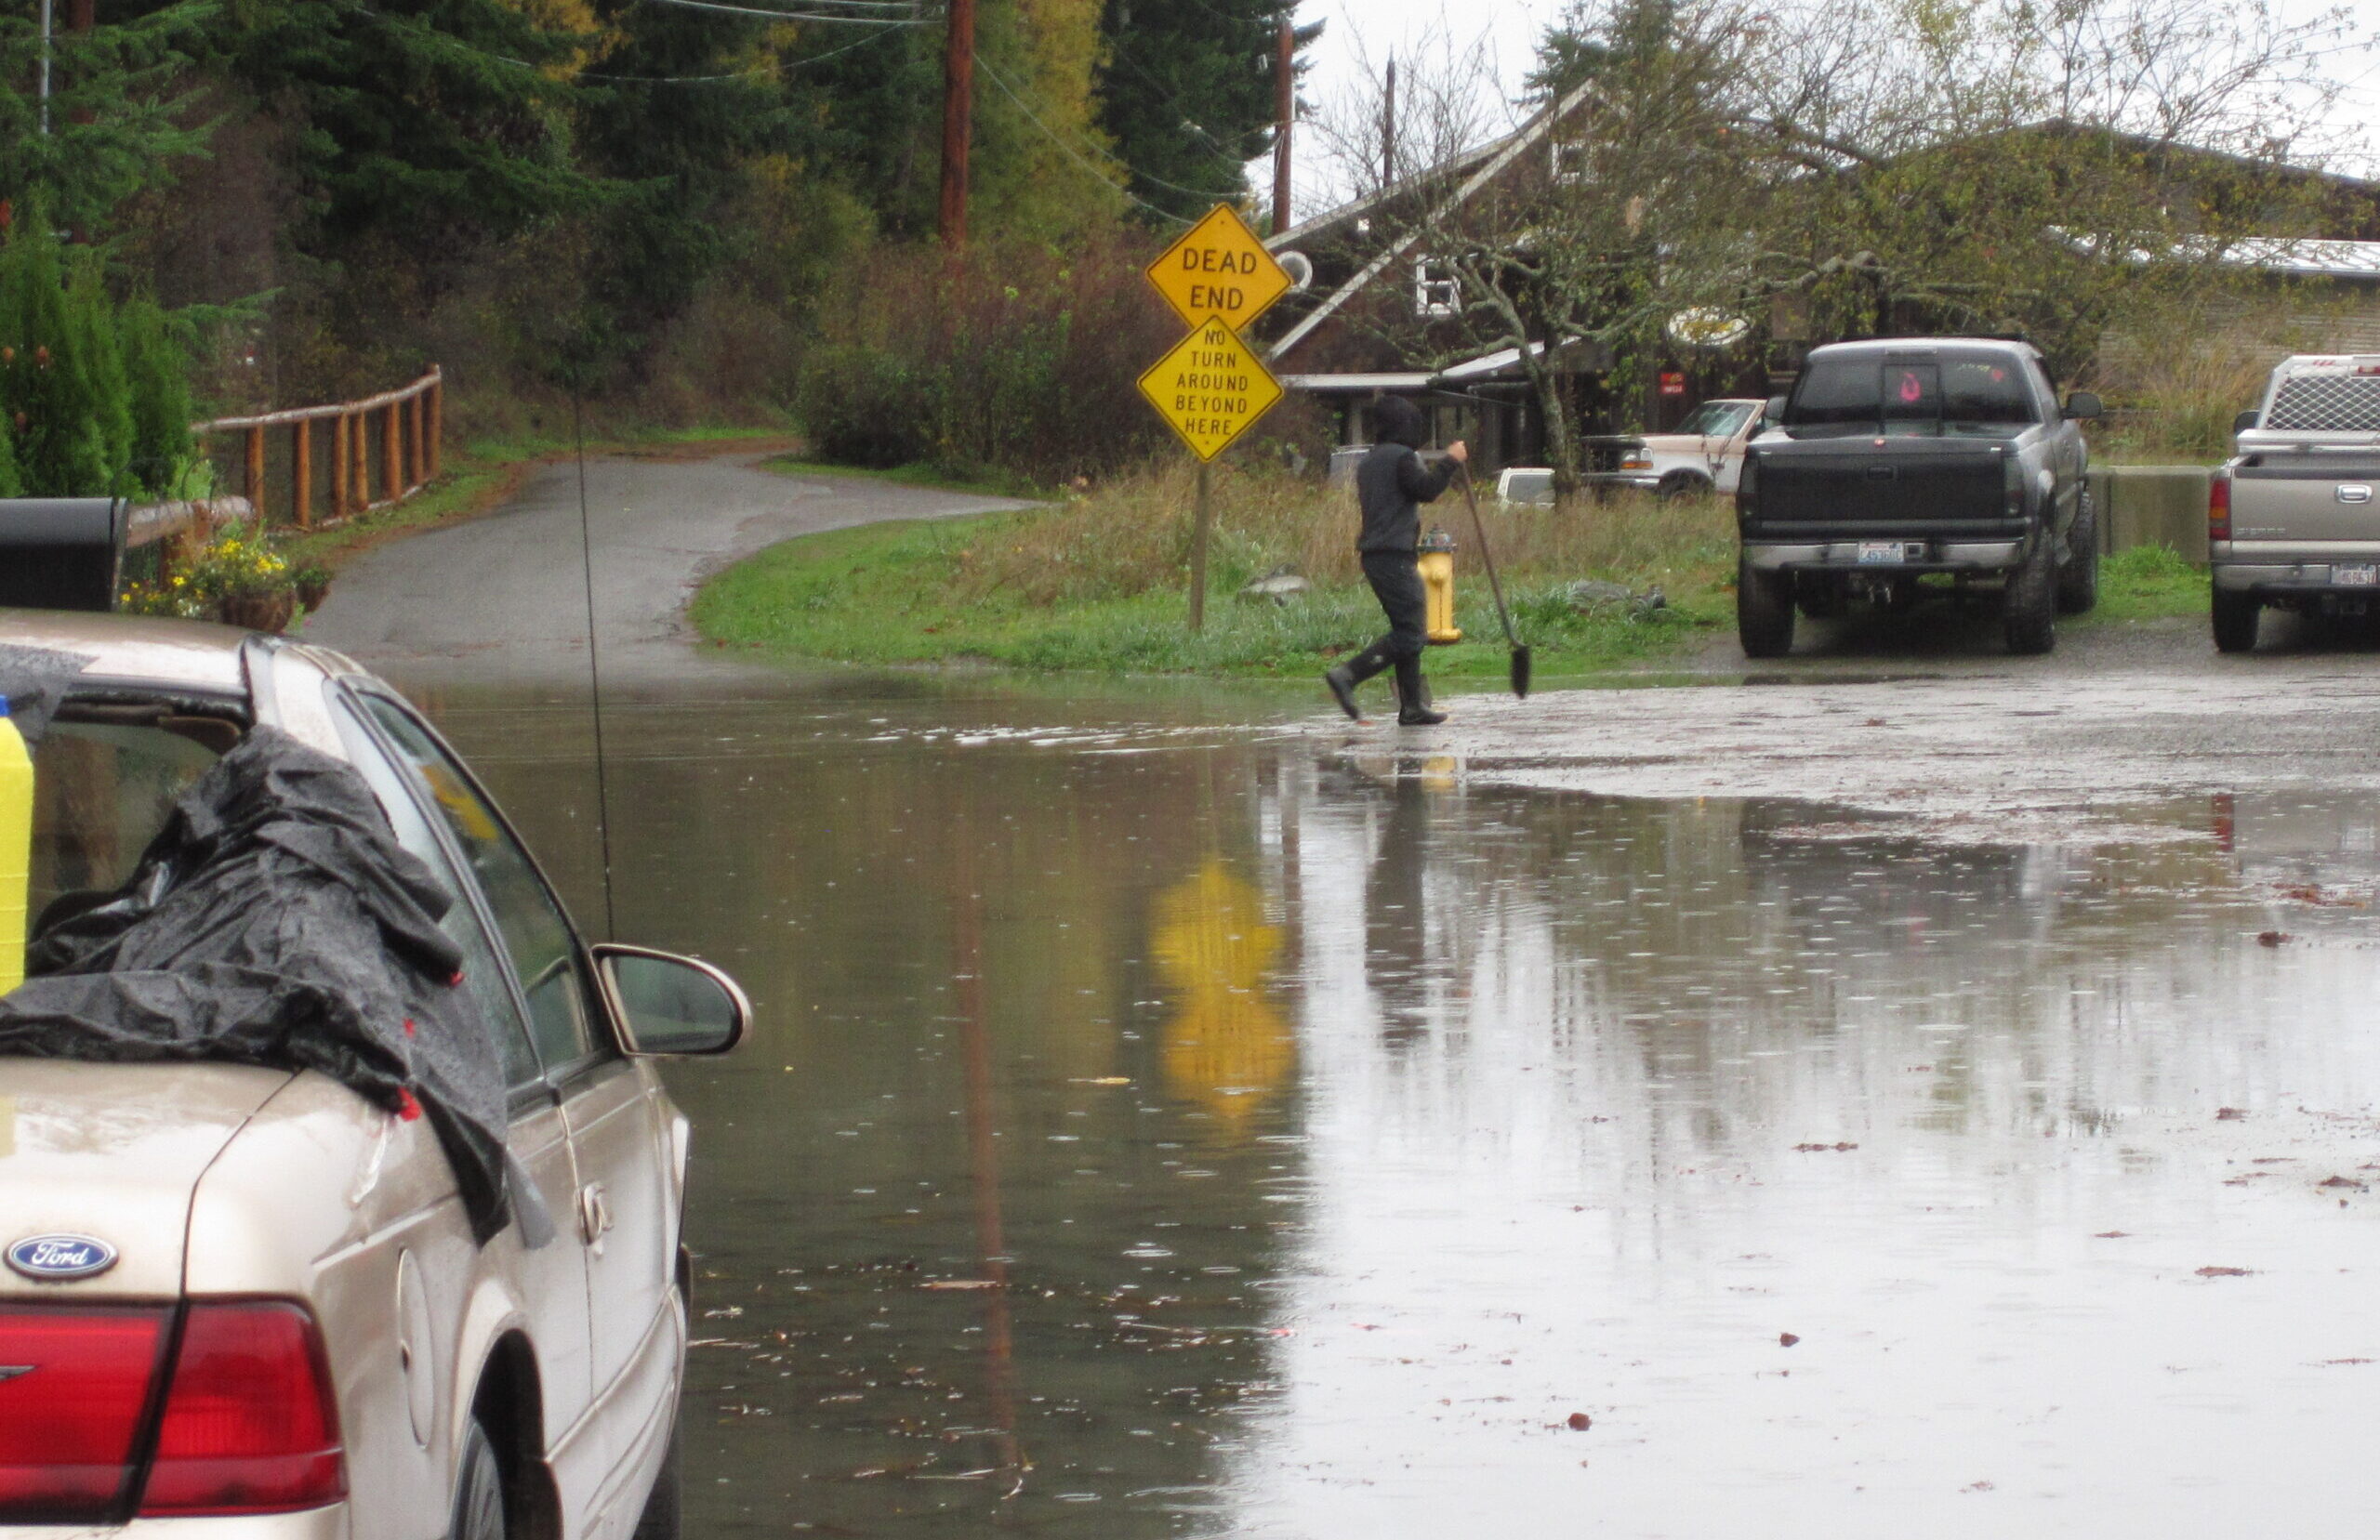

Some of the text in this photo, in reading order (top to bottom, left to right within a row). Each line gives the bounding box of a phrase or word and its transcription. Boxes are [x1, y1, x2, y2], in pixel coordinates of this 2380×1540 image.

[1183, 248, 1257, 274] DEAD
[1190, 285, 1243, 310] END
[1205, 329, 1225, 346] NO
[1191, 350, 1236, 368] TURN
[1177, 374, 1248, 391] AROUND
[1176, 395, 1247, 414] BEYOND
[1184, 419, 1232, 436] HERE
[32, 1243, 89, 1265] Ford
